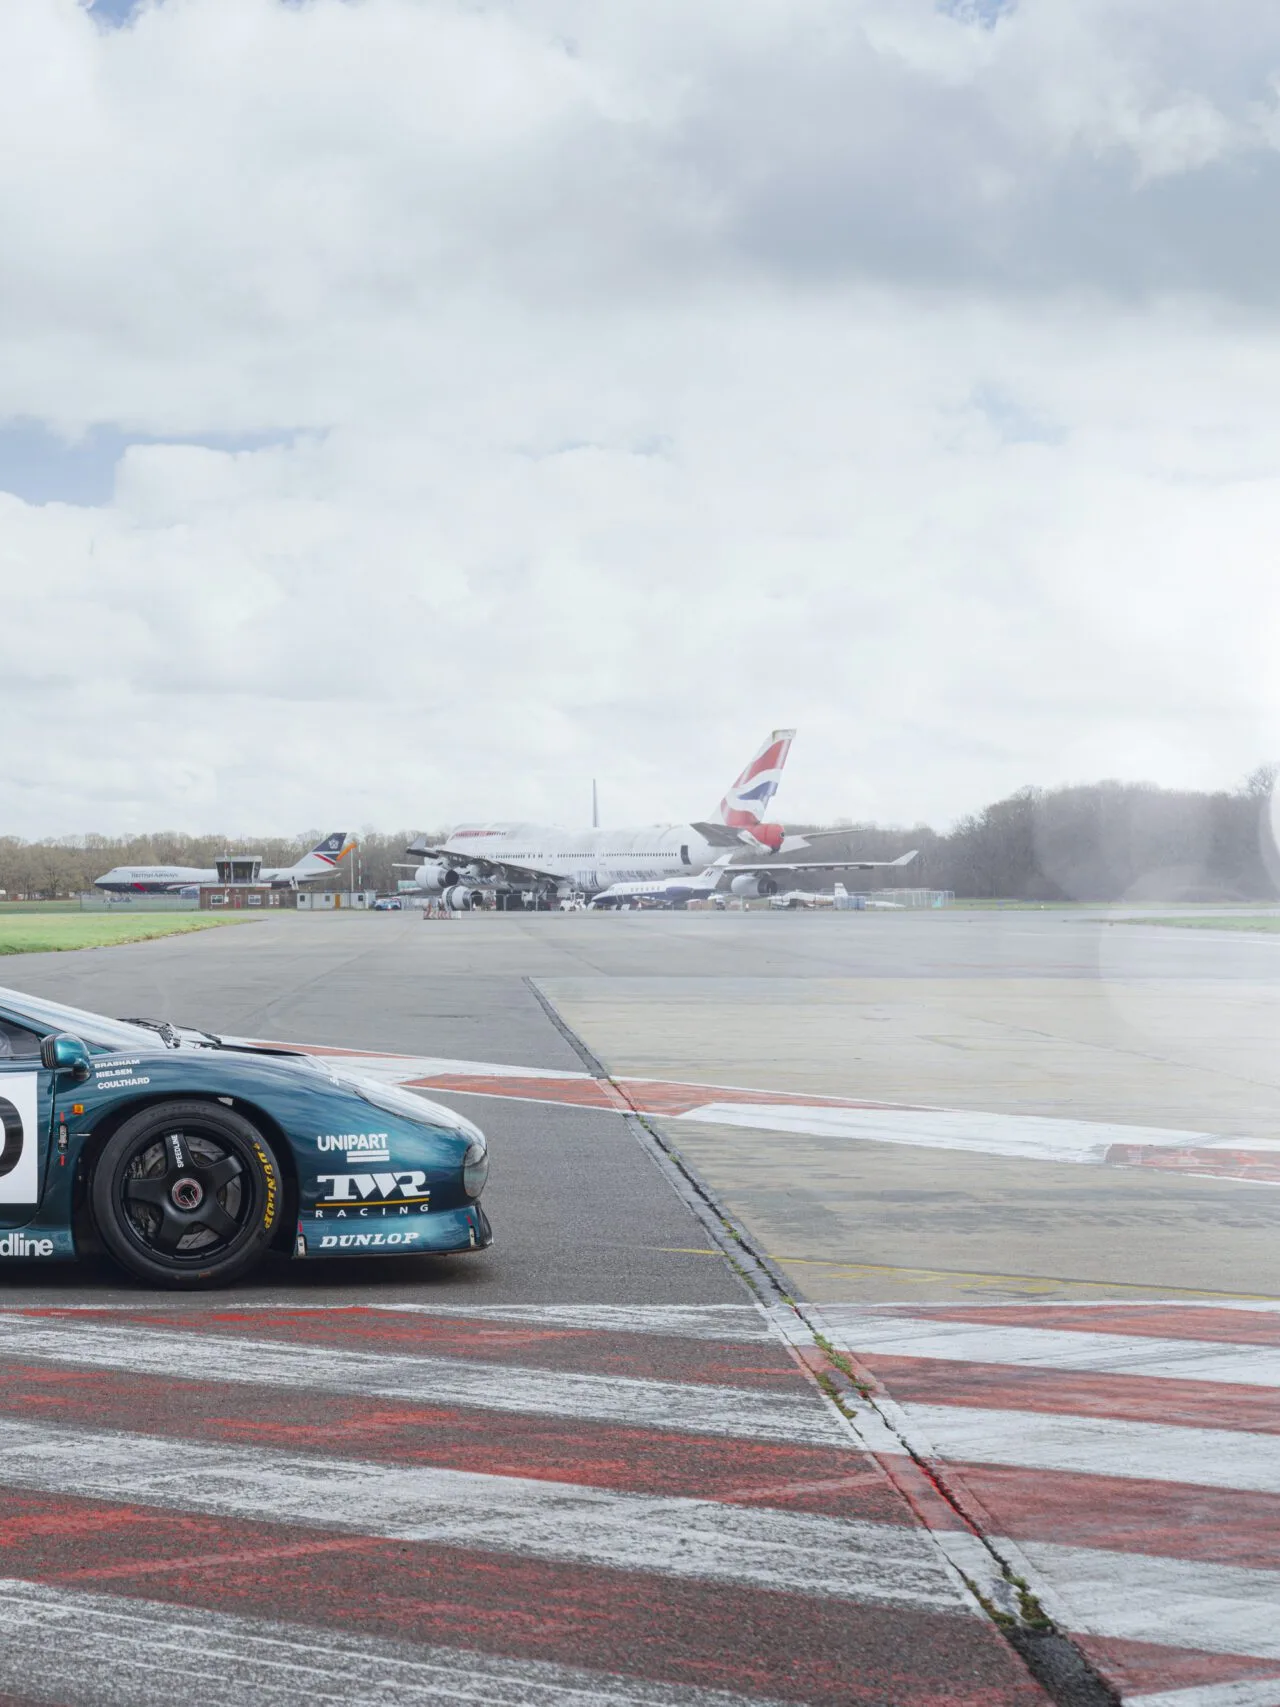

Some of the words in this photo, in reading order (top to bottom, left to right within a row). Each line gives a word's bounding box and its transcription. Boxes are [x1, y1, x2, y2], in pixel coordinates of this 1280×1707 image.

[94, 1059, 140, 1069] BRABHAM
[95, 1068, 133, 1078] NIELSEN
[97, 1077, 150, 1090] COULTHARD
[317, 1133, 388, 1152] UNIPART
[170, 1133, 185, 1169] SPEEDLINE
[258, 1151, 277, 1229] DUNLOP
[317, 1170, 431, 1201] TWR
[315, 1203, 429, 1218] RACING
[319, 1232, 420, 1248] DUNLOP
